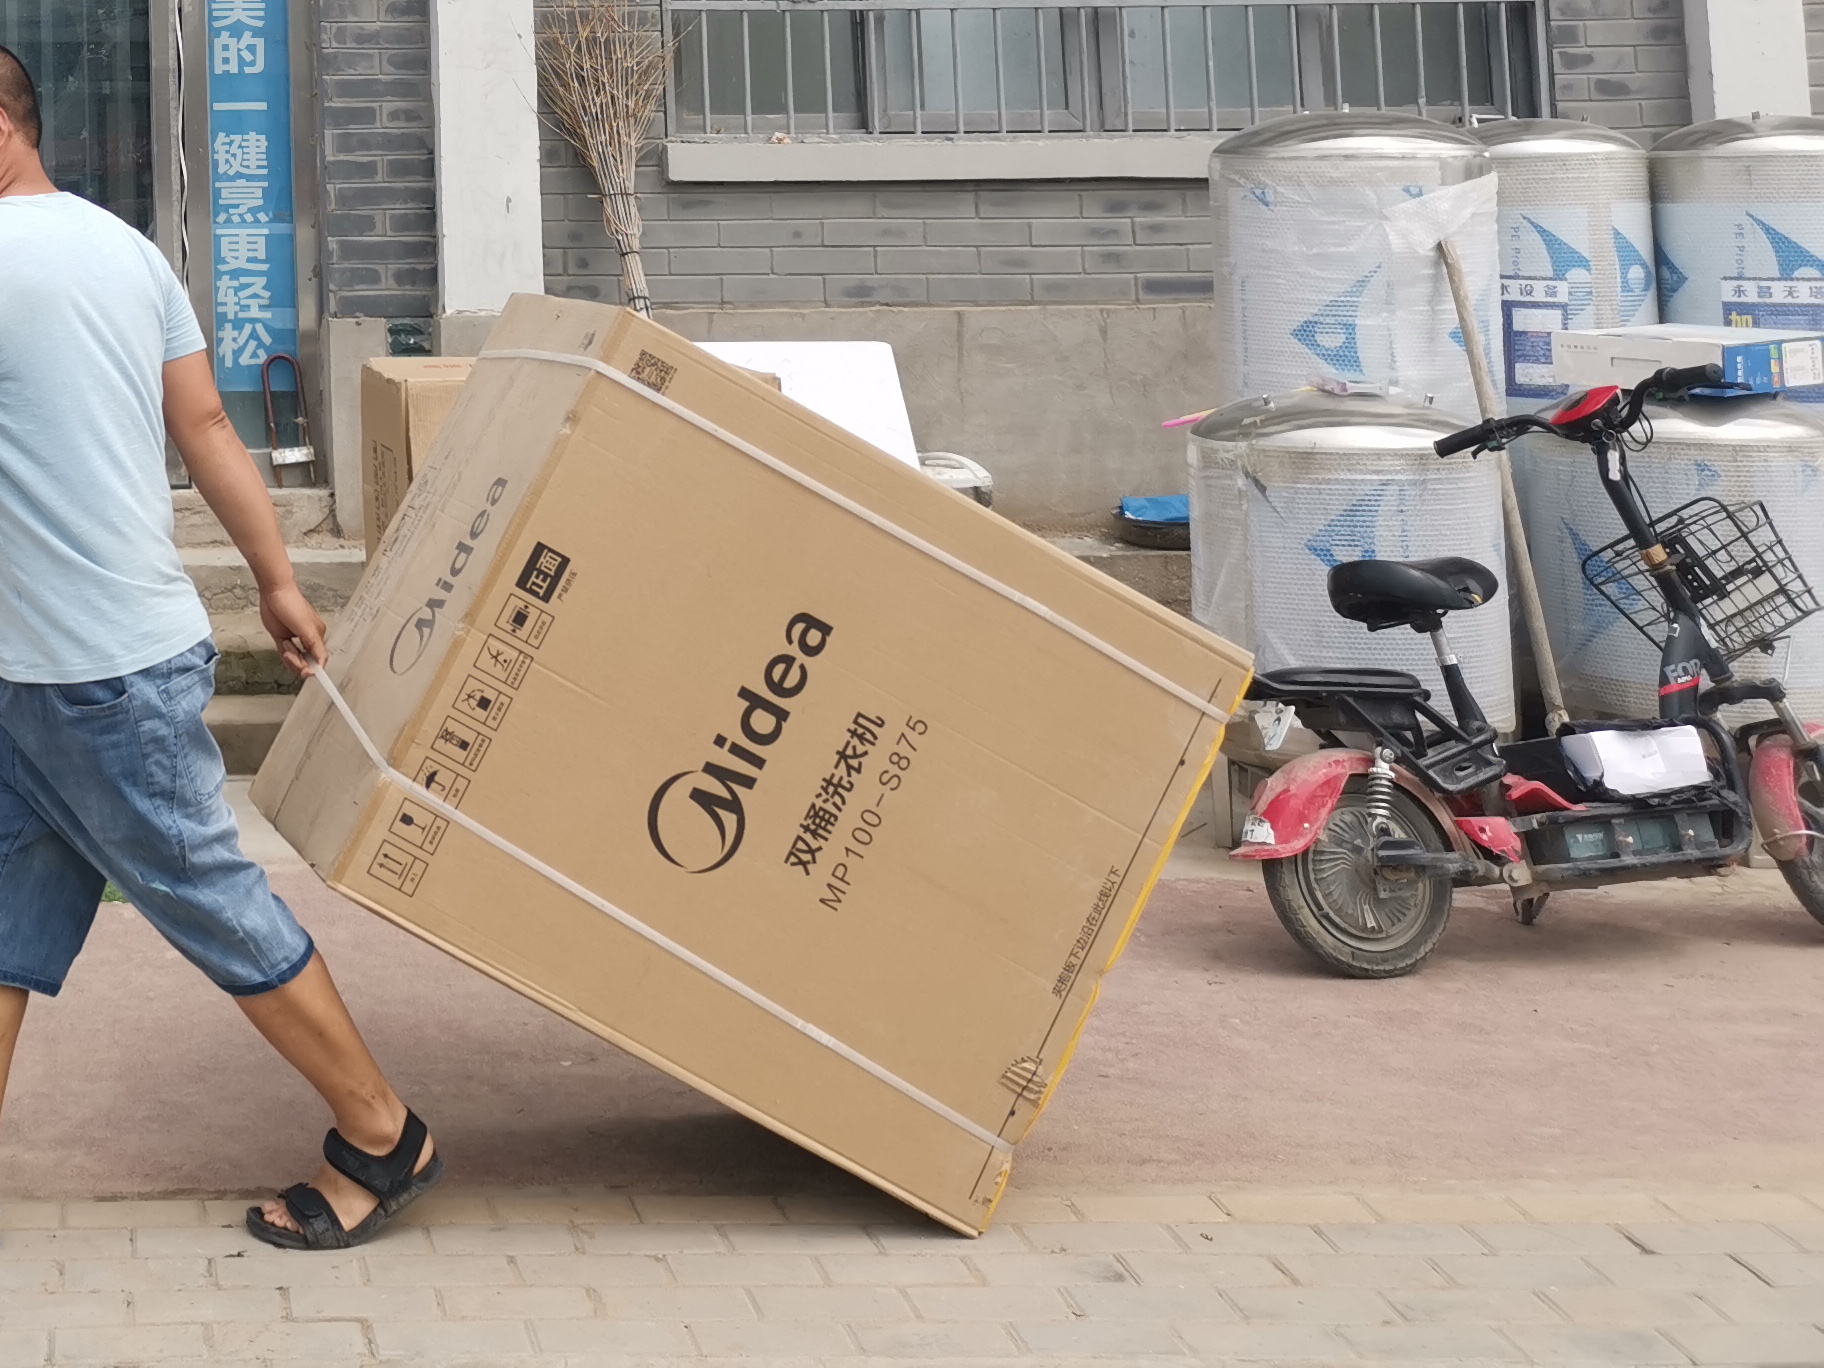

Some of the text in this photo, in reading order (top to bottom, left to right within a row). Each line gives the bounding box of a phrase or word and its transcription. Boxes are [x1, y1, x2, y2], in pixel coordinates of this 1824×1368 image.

[212, 100, 273, 369] 一键烹更轻松
[389, 477, 508, 675] Midea
[526, 548, 563, 597] 正面
[647, 611, 834, 874] Midea
[784, 711, 886, 877] 双桶洗衣机
[819, 715, 929, 912] MP100-S875
